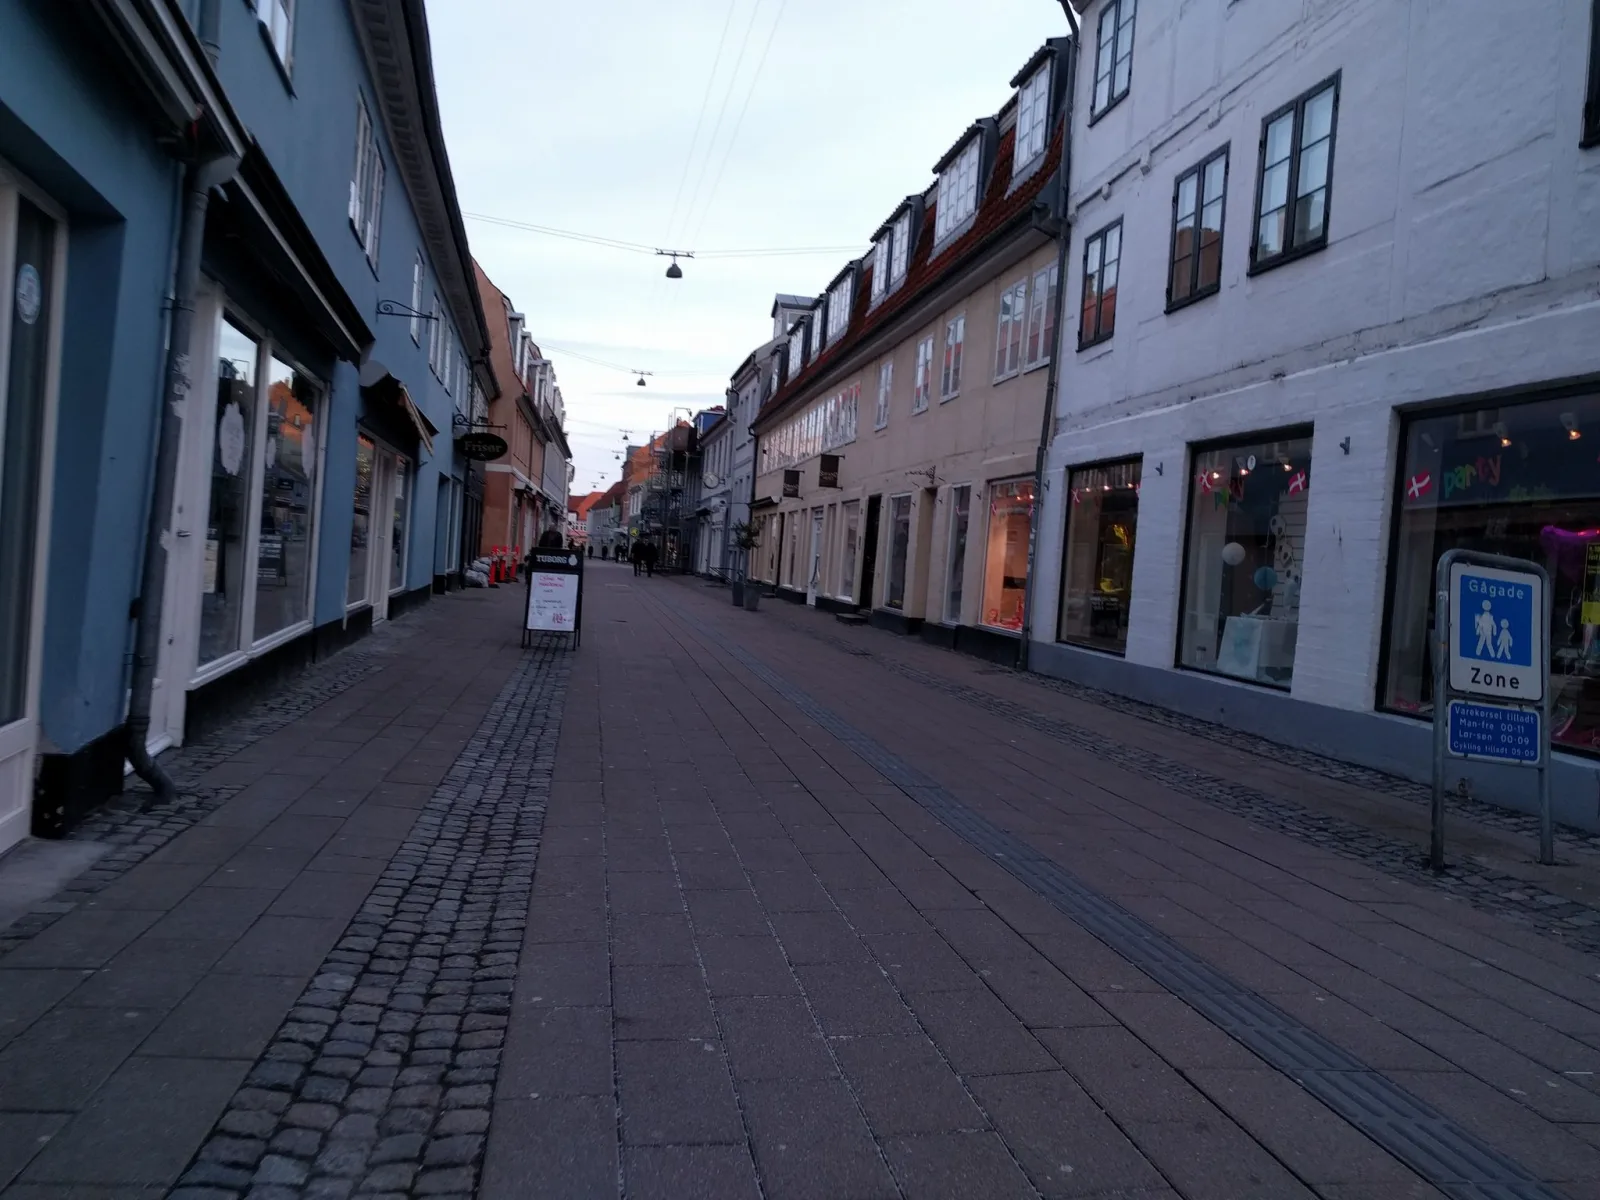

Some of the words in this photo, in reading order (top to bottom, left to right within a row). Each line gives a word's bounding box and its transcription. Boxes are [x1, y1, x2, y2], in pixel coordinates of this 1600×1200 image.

[1443, 454, 1502, 499] party
[535, 554, 568, 565] TUBORG
[1468, 579, 1524, 599] Gågade
[1470, 667, 1520, 689] Zone
[1454, 705, 1502, 720] Varekørsel
[1506, 712, 1534, 724] tilladt
[1459, 717, 1494, 730] Man-fre
[1500, 723, 1525, 734] 00-11
[1458, 729, 1492, 741] Lør-søn
[1500, 734, 1529, 745] 00-09
[1453, 740, 1481, 752] Cykling
[1484, 745, 1508, 754] tilladt
